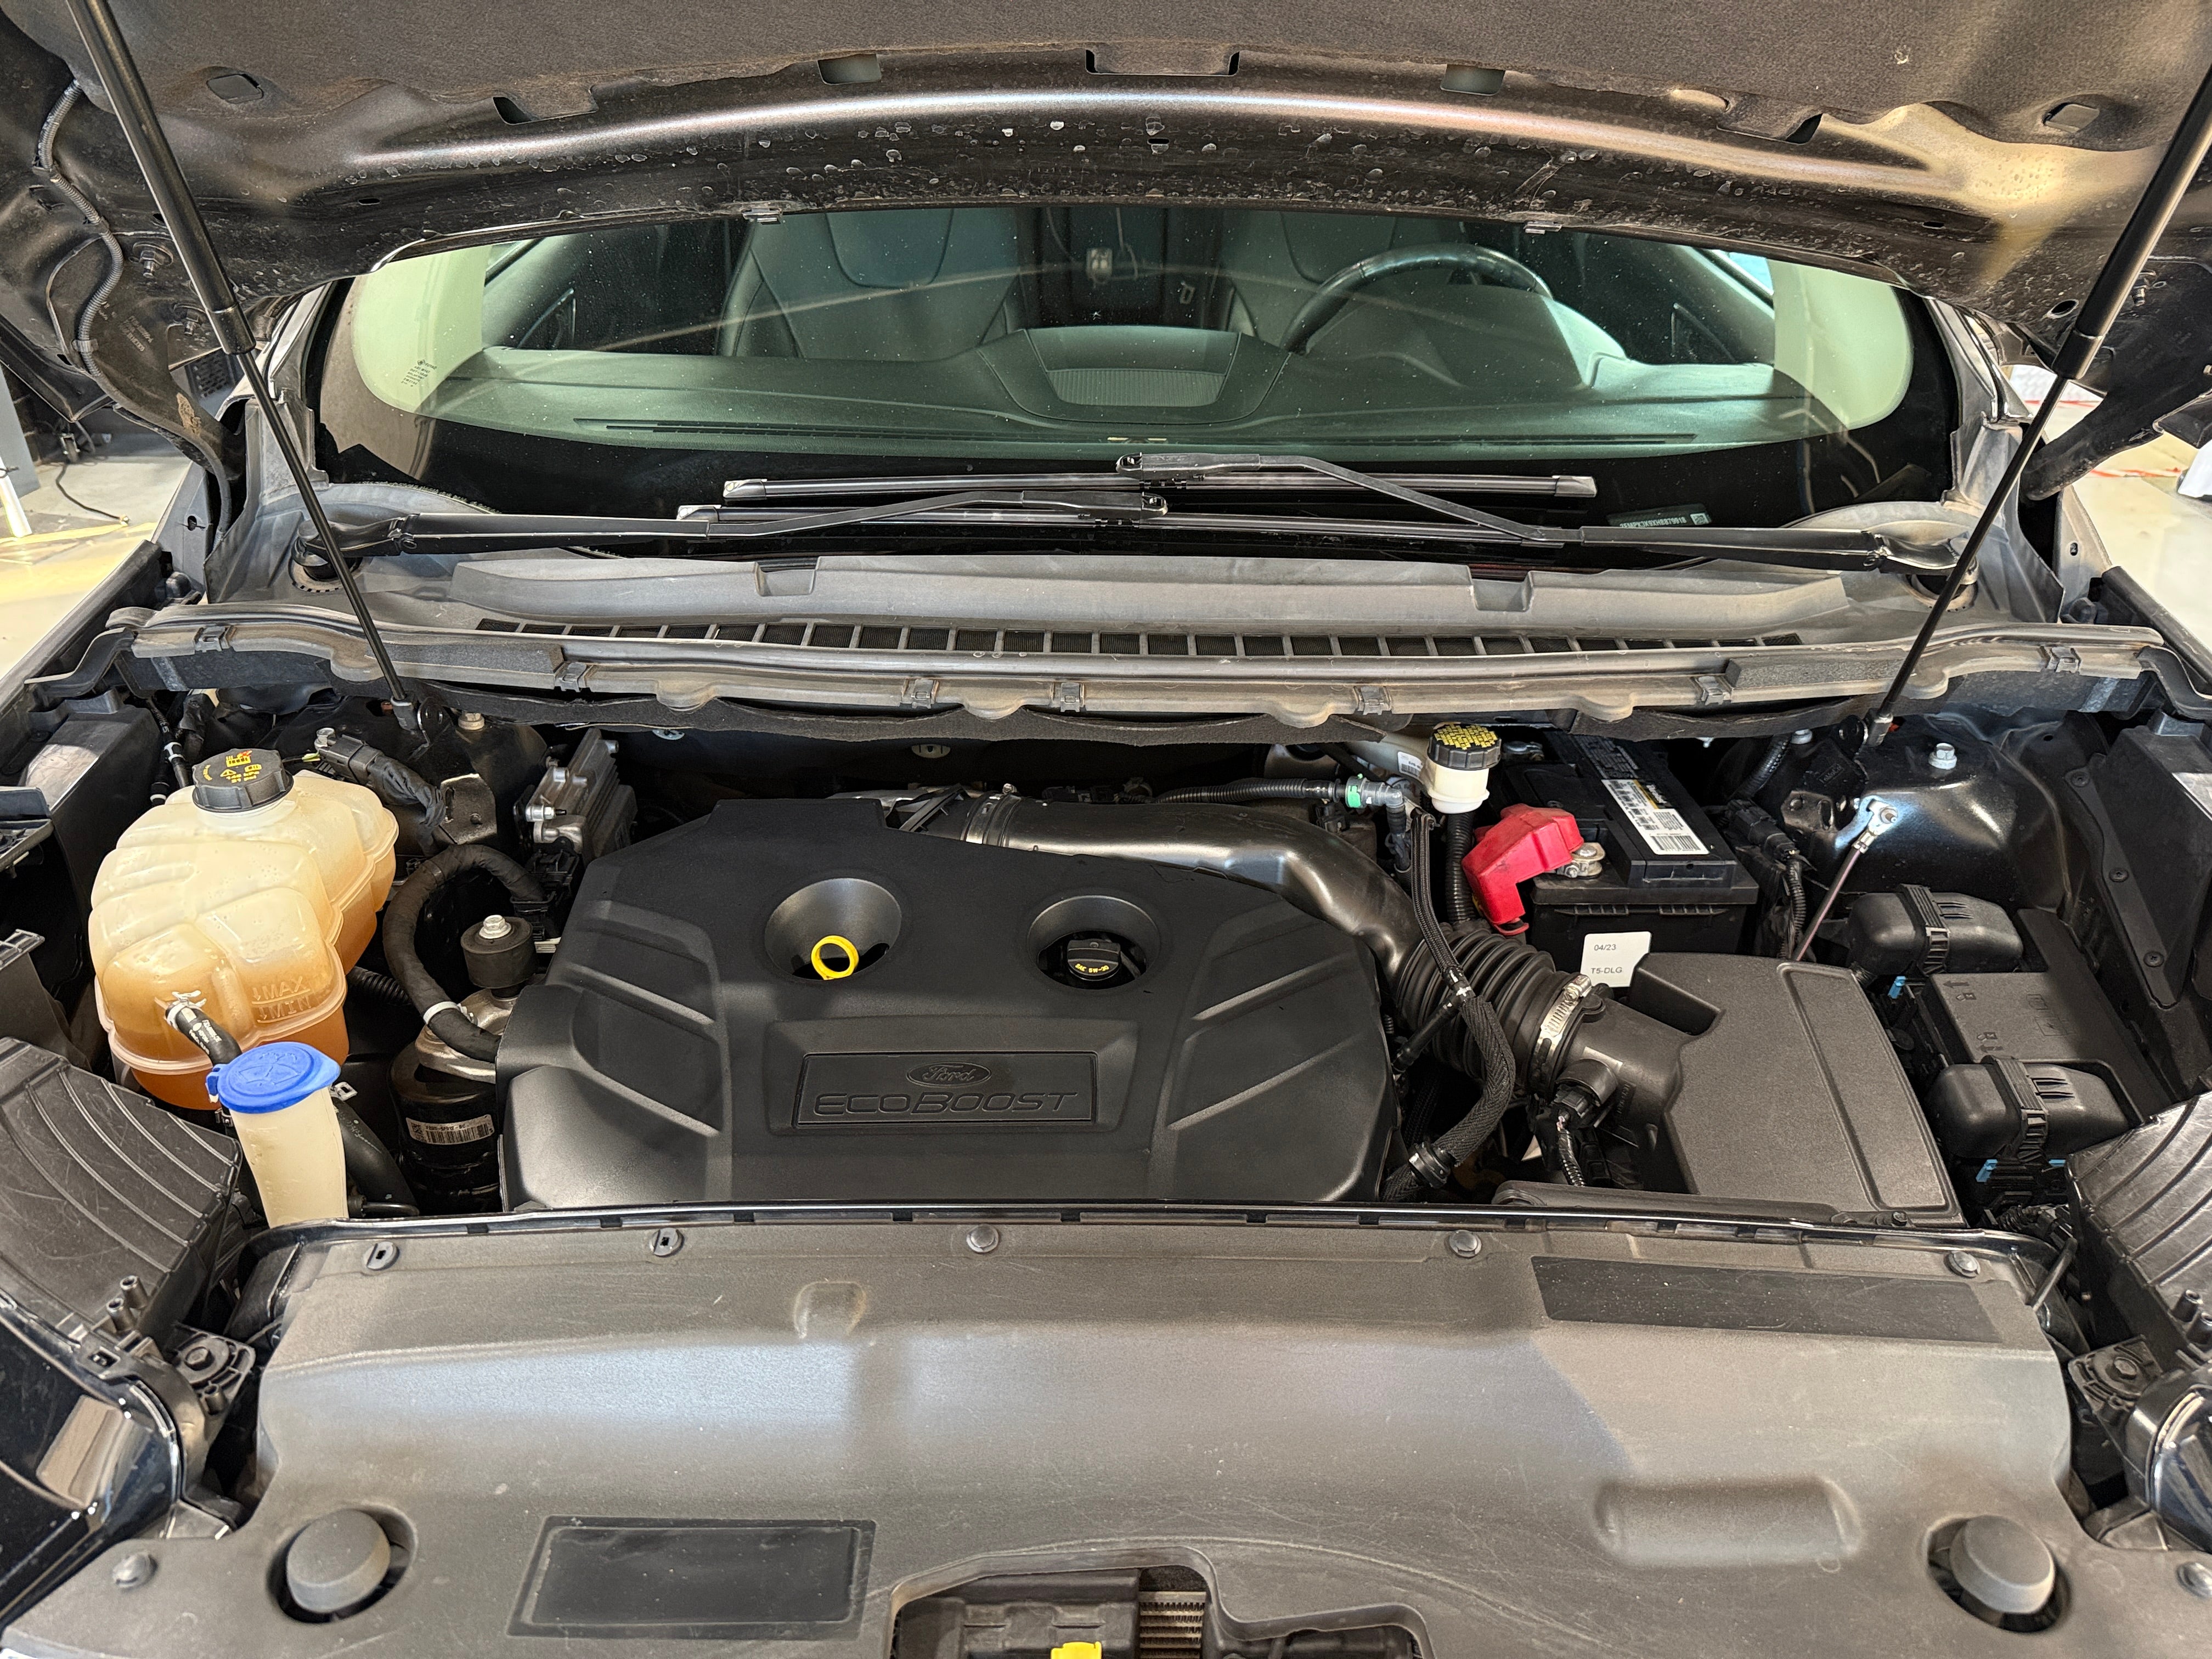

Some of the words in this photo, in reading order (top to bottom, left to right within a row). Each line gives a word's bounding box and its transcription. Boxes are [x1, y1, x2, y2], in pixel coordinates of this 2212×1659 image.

[1075, 963, 1087, 972] SAE
[1088, 965, 1109, 973] 5W-30
[262, 976, 307, 1000] MAX
[268, 995, 312, 1019] MIN
[922, 1064, 977, 1081] Ford
[814, 1092, 1078, 1116] ECOBOOST
